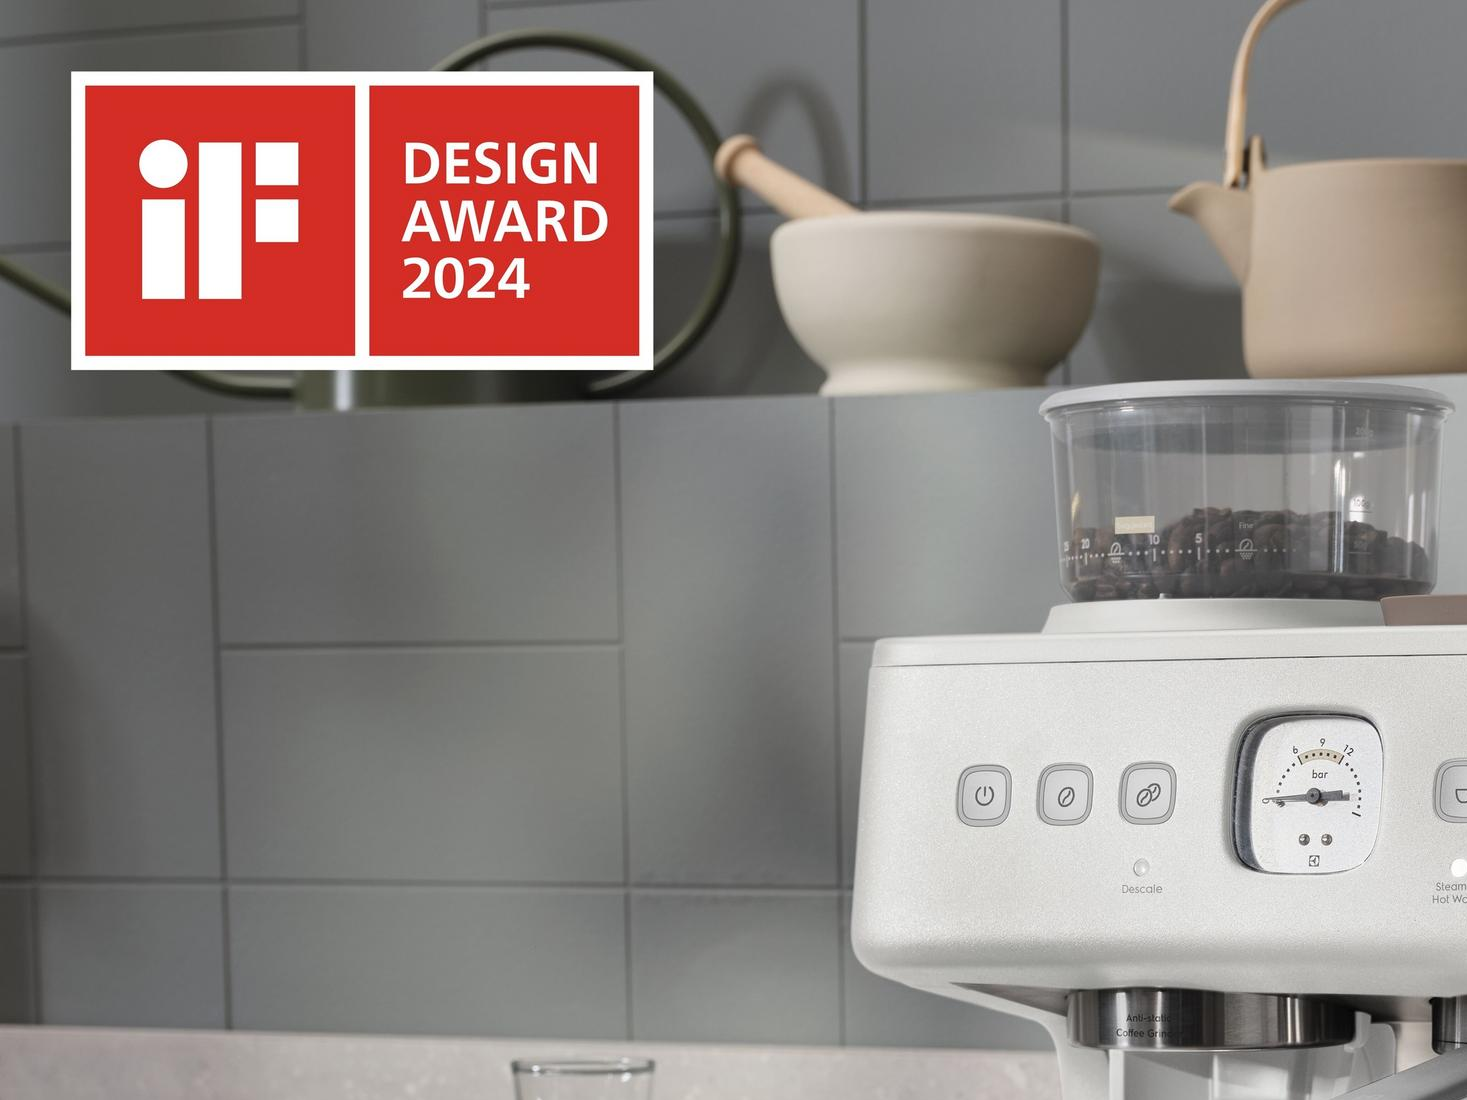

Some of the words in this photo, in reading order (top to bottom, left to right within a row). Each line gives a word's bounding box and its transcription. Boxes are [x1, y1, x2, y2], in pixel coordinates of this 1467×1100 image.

[1149, 534, 1160, 546] 10
[1195, 532, 1203, 544] 5
[1292, 745, 1299, 755] 6
[1319, 737, 1326, 748] 9
[1343, 744, 1355, 757] 12
[1311, 769, 1329, 780] bar
[1121, 884, 1163, 894] Descale
[1435, 881, 1467, 891] Steam
[1432, 895, 1450, 904] Hot
[1116, 1028, 1145, 1038] Coffee
